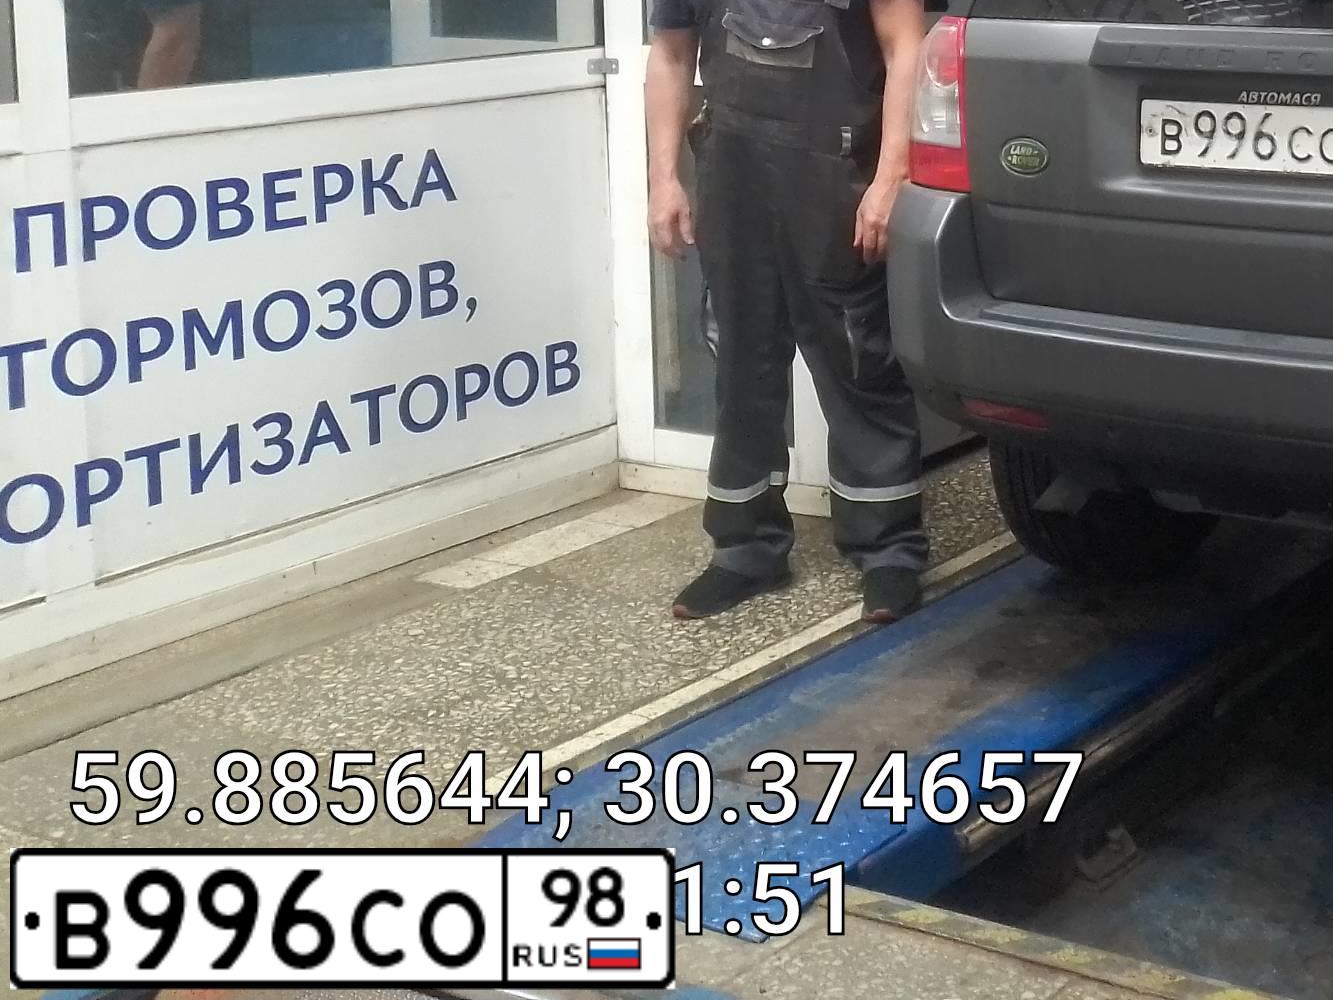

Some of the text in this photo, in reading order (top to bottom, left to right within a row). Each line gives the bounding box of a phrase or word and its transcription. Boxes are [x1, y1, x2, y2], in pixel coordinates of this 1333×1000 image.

[1237, 90, 1321, 106] АВТОМАСЯ
[13, 147, 457, 273] ПРОВЕРКА
[0, 259, 478, 411] ТОРМОЗОВ,
[0, 339, 582, 545] ОРТИЗАТОРОВ
